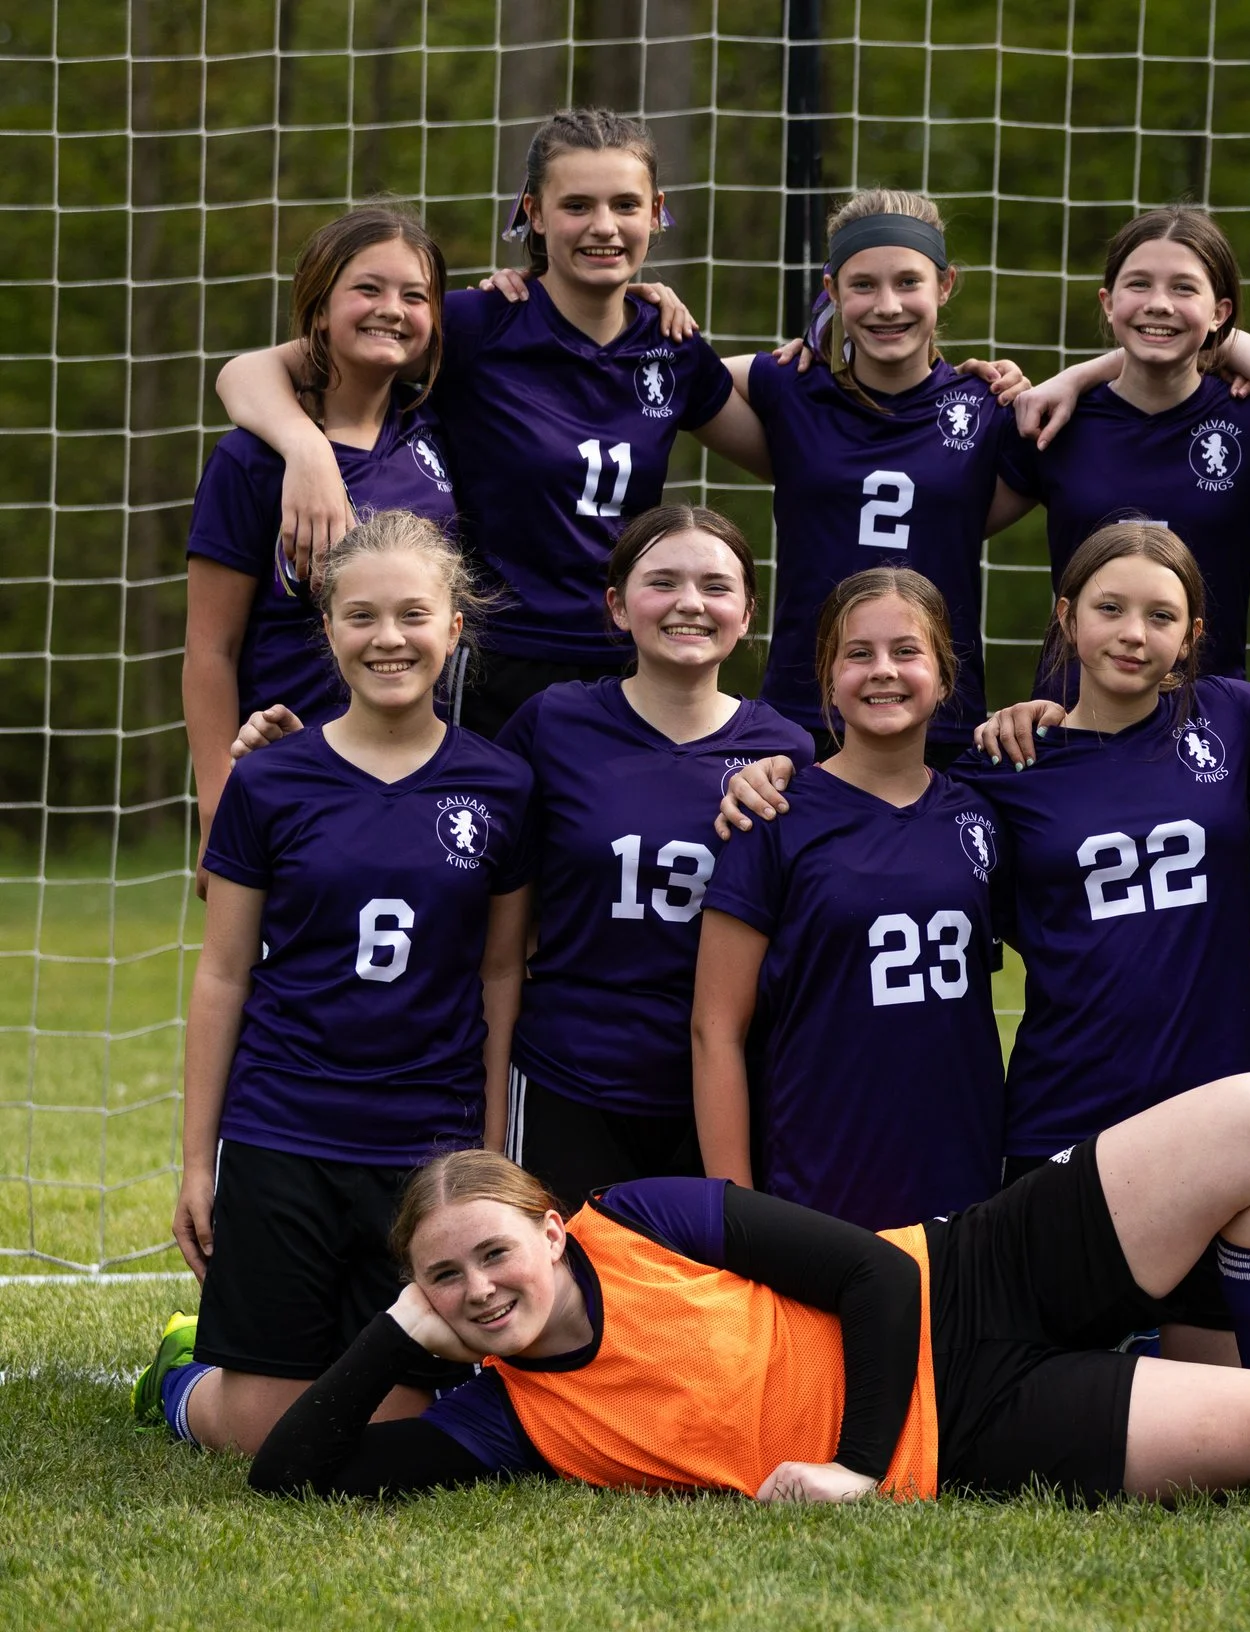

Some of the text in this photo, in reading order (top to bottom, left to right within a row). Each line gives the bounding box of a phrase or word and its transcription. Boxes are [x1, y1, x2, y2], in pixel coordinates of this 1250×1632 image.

[935, 391, 984, 408] CALVARY
[642, 406, 673, 419] KINGS
[1190, 419, 1243, 437] CALVARY
[942, 438, 975, 451] KINGS
[575, 438, 633, 518] 11
[1196, 478, 1235, 492] KINGS
[858, 469, 916, 550] 2
[1195, 766, 1229, 783] KINGS
[436, 795, 492, 819] CALVARY
[954, 811, 997, 835] CALVARY
[445, 853, 480, 870] KINGS
[1076, 818, 1208, 921] 22
[610, 833, 716, 923] 13
[354, 898, 416, 983] 6
[868, 909, 973, 1007] 23
